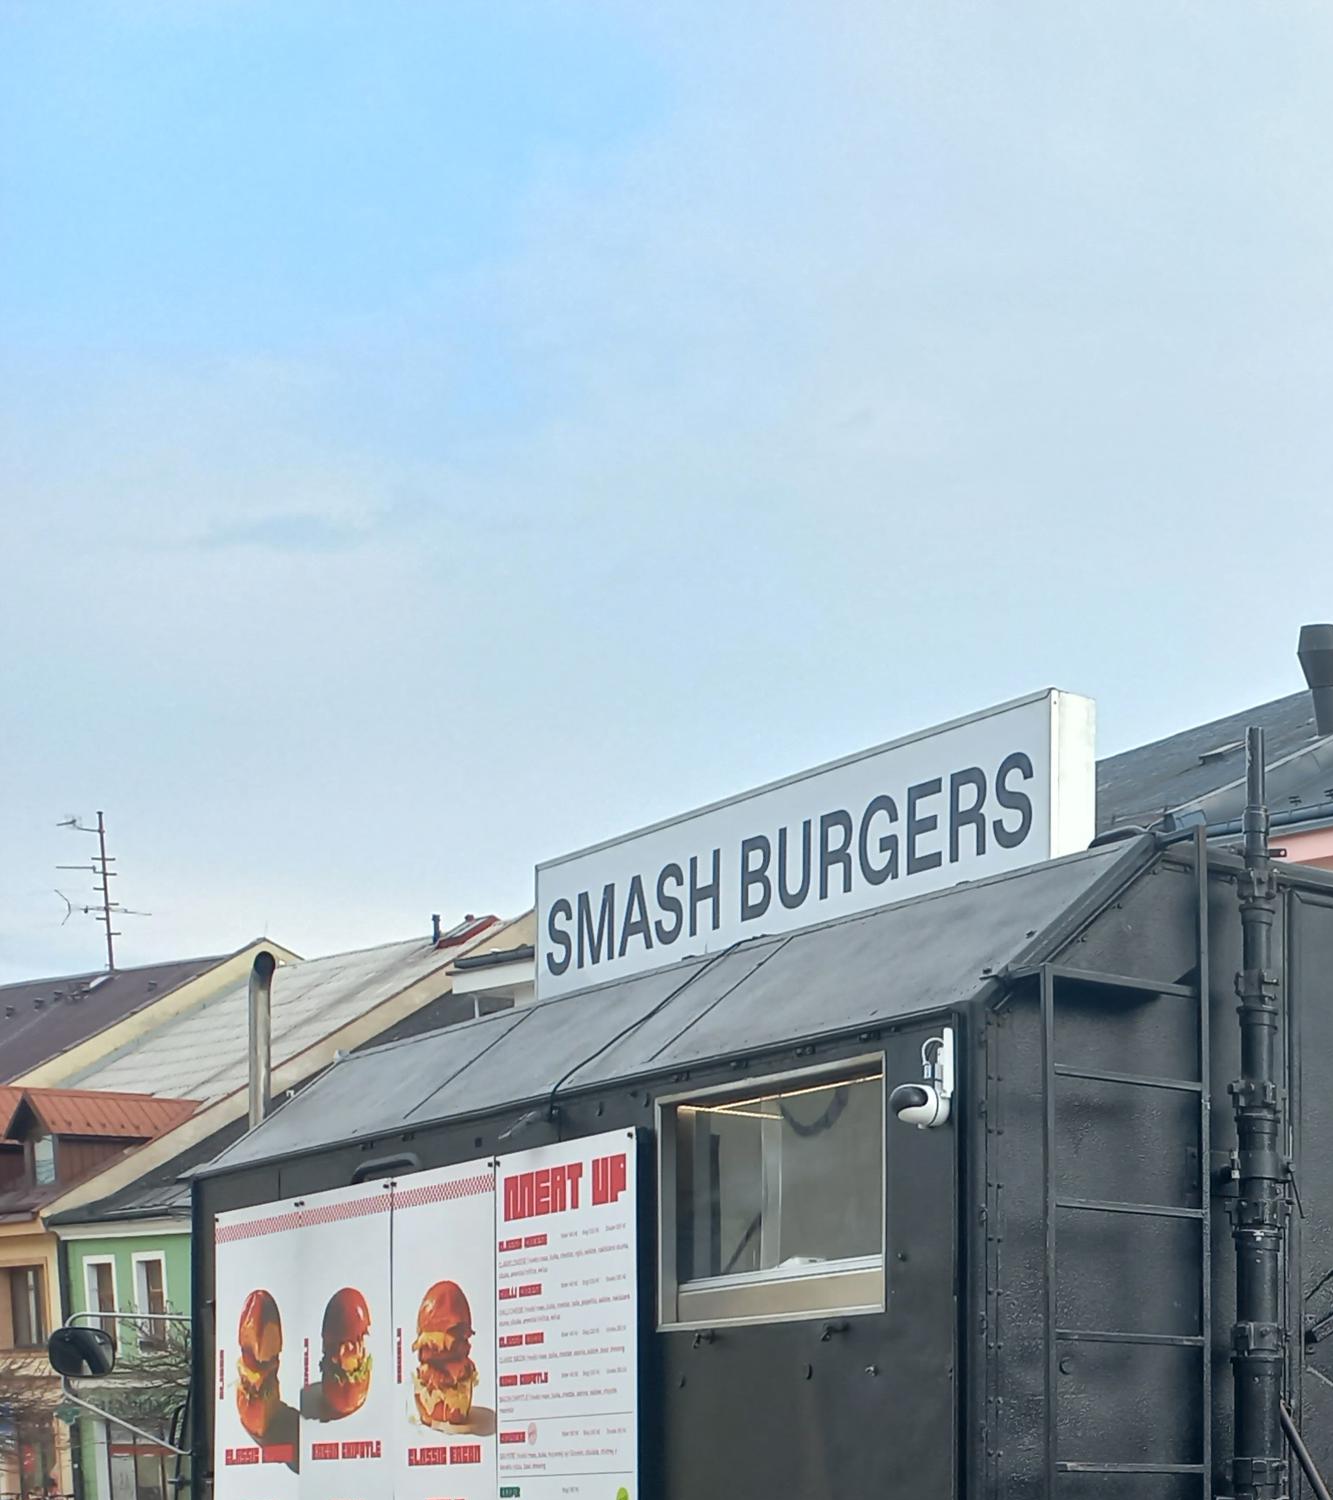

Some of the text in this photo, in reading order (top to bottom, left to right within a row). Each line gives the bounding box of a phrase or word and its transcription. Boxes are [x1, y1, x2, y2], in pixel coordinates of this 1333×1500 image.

[546, 751, 1034, 976] SMASH BURGERS
[503, 1153, 626, 1222] MEAT UP
